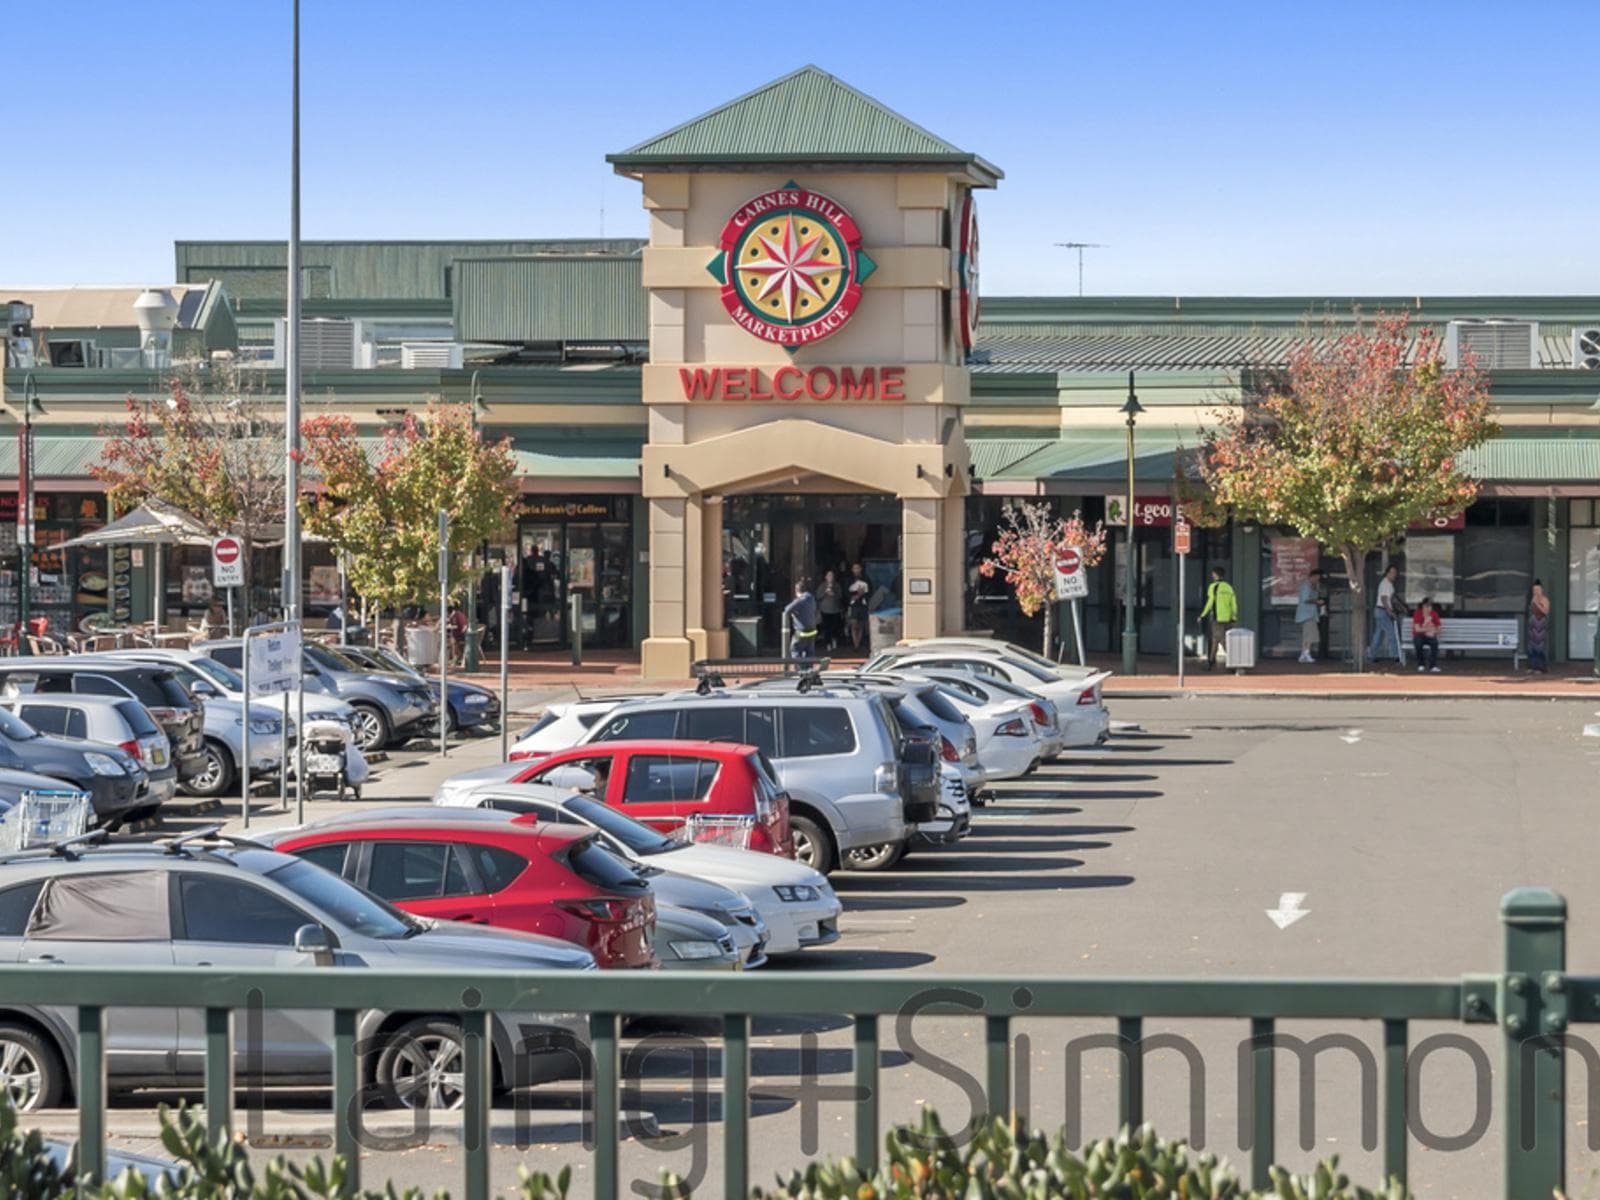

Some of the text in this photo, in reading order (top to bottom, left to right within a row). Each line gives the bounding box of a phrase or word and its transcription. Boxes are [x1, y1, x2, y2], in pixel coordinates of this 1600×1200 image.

[734, 192, 844, 228] CARNES HILL
[732, 305, 849, 342] MARKETPLACE
[679, 366, 906, 400] WELCOME
[221, 565, 235, 574] NO
[217, 575, 239, 583] ENTRY
[1063, 576, 1078, 586] NO
[1060, 586, 1082, 595] ENTRY
